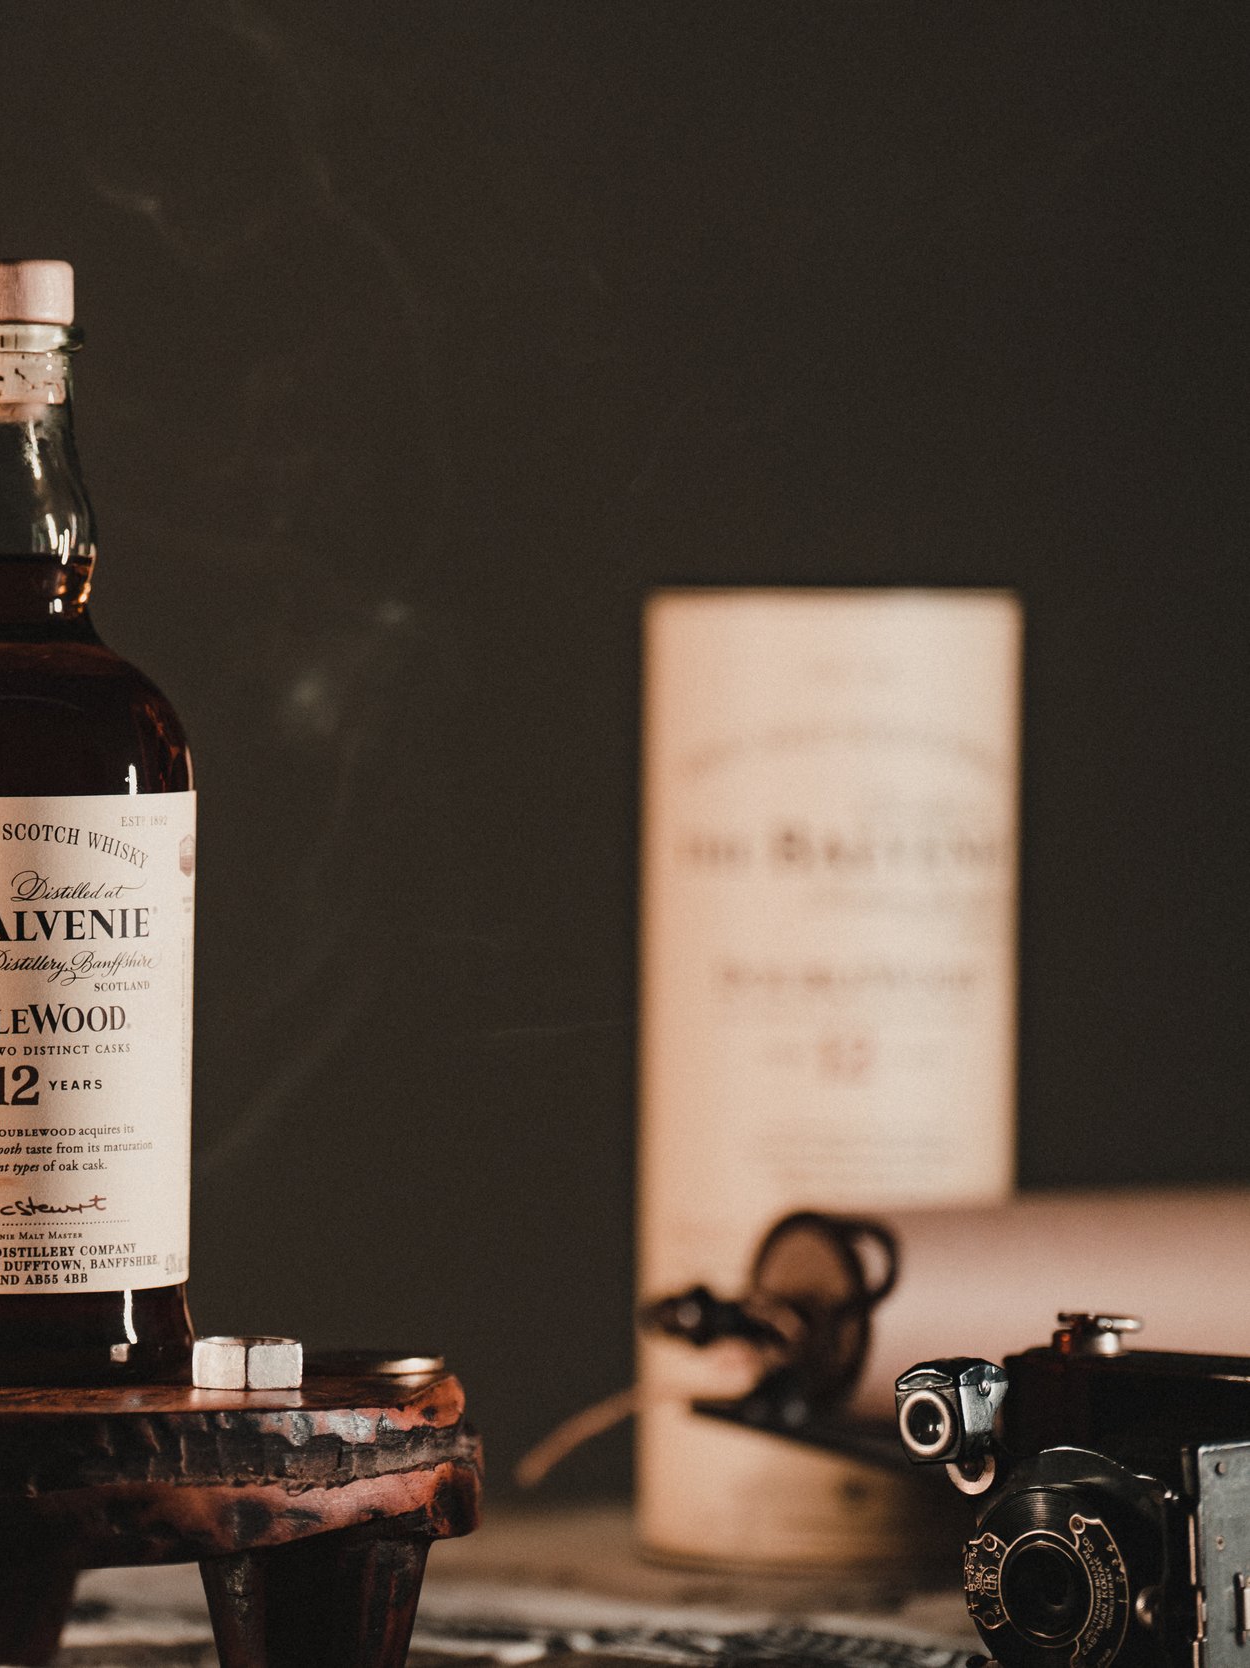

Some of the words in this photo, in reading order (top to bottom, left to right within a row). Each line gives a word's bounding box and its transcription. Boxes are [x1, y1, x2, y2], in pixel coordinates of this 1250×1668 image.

[2, 823, 81, 846] SCOTCH
[88, 831, 149, 869] WHISKY
[11, 870, 105, 902] Distilled
[104, 878, 147, 899] at
[61, 950, 156, 986] Banffshire
[94, 980, 150, 992] SCOTLAND
[23, 1045, 90, 1056] DISTINCT
[95, 1043, 131, 1054] CASKS
[49, 1079, 103, 1091] YEARS
[78, 1125, 121, 1139] acquires
[123, 1123, 135, 1134] its
[25, 1145, 53, 1155] taste
[56, 1142, 84, 1154] from
[88, 1142, 100, 1153] its
[103, 1140, 153, 1153] maturation
[12, 1163, 40, 1176] types
[43, 1160, 57, 1172] of
[58, 1159, 79, 1171] oak
[82, 1158, 108, 1171] cask.
[19, 1232, 45, 1240] MALT
[48, 1231, 83, 1240] MASTER
[80, 1243, 137, 1256] COMPANY
[4, 1260, 86, 1272] DUFFTOWN,
[25, 1274, 59, 1286] AB55
[64, 1273, 88, 1284] 4BB
[1094, 1557, 1108, 1598] KODAK
[1082, 1603, 1108, 1656] EASTMAN
